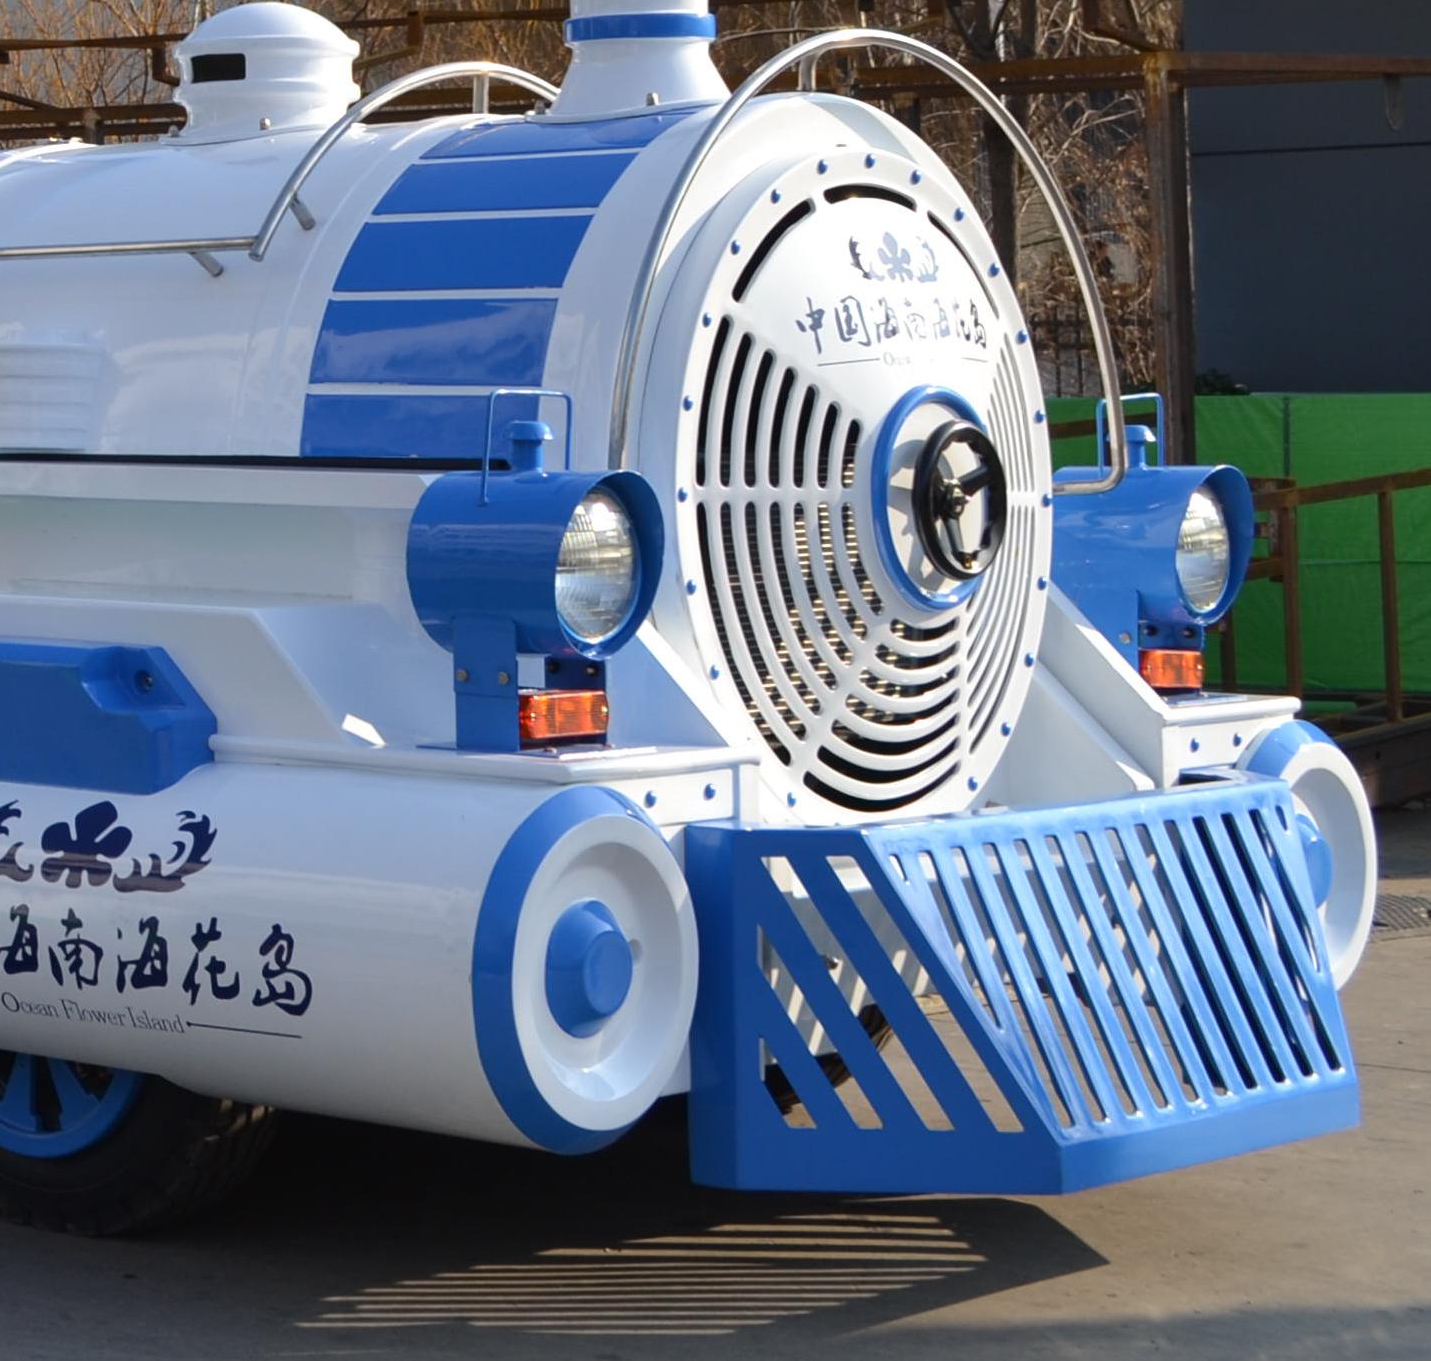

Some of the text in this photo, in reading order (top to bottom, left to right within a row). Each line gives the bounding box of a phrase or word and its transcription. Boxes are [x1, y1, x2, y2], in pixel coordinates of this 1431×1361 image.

[1, 991, 185, 1033] Ocean Flower Island
